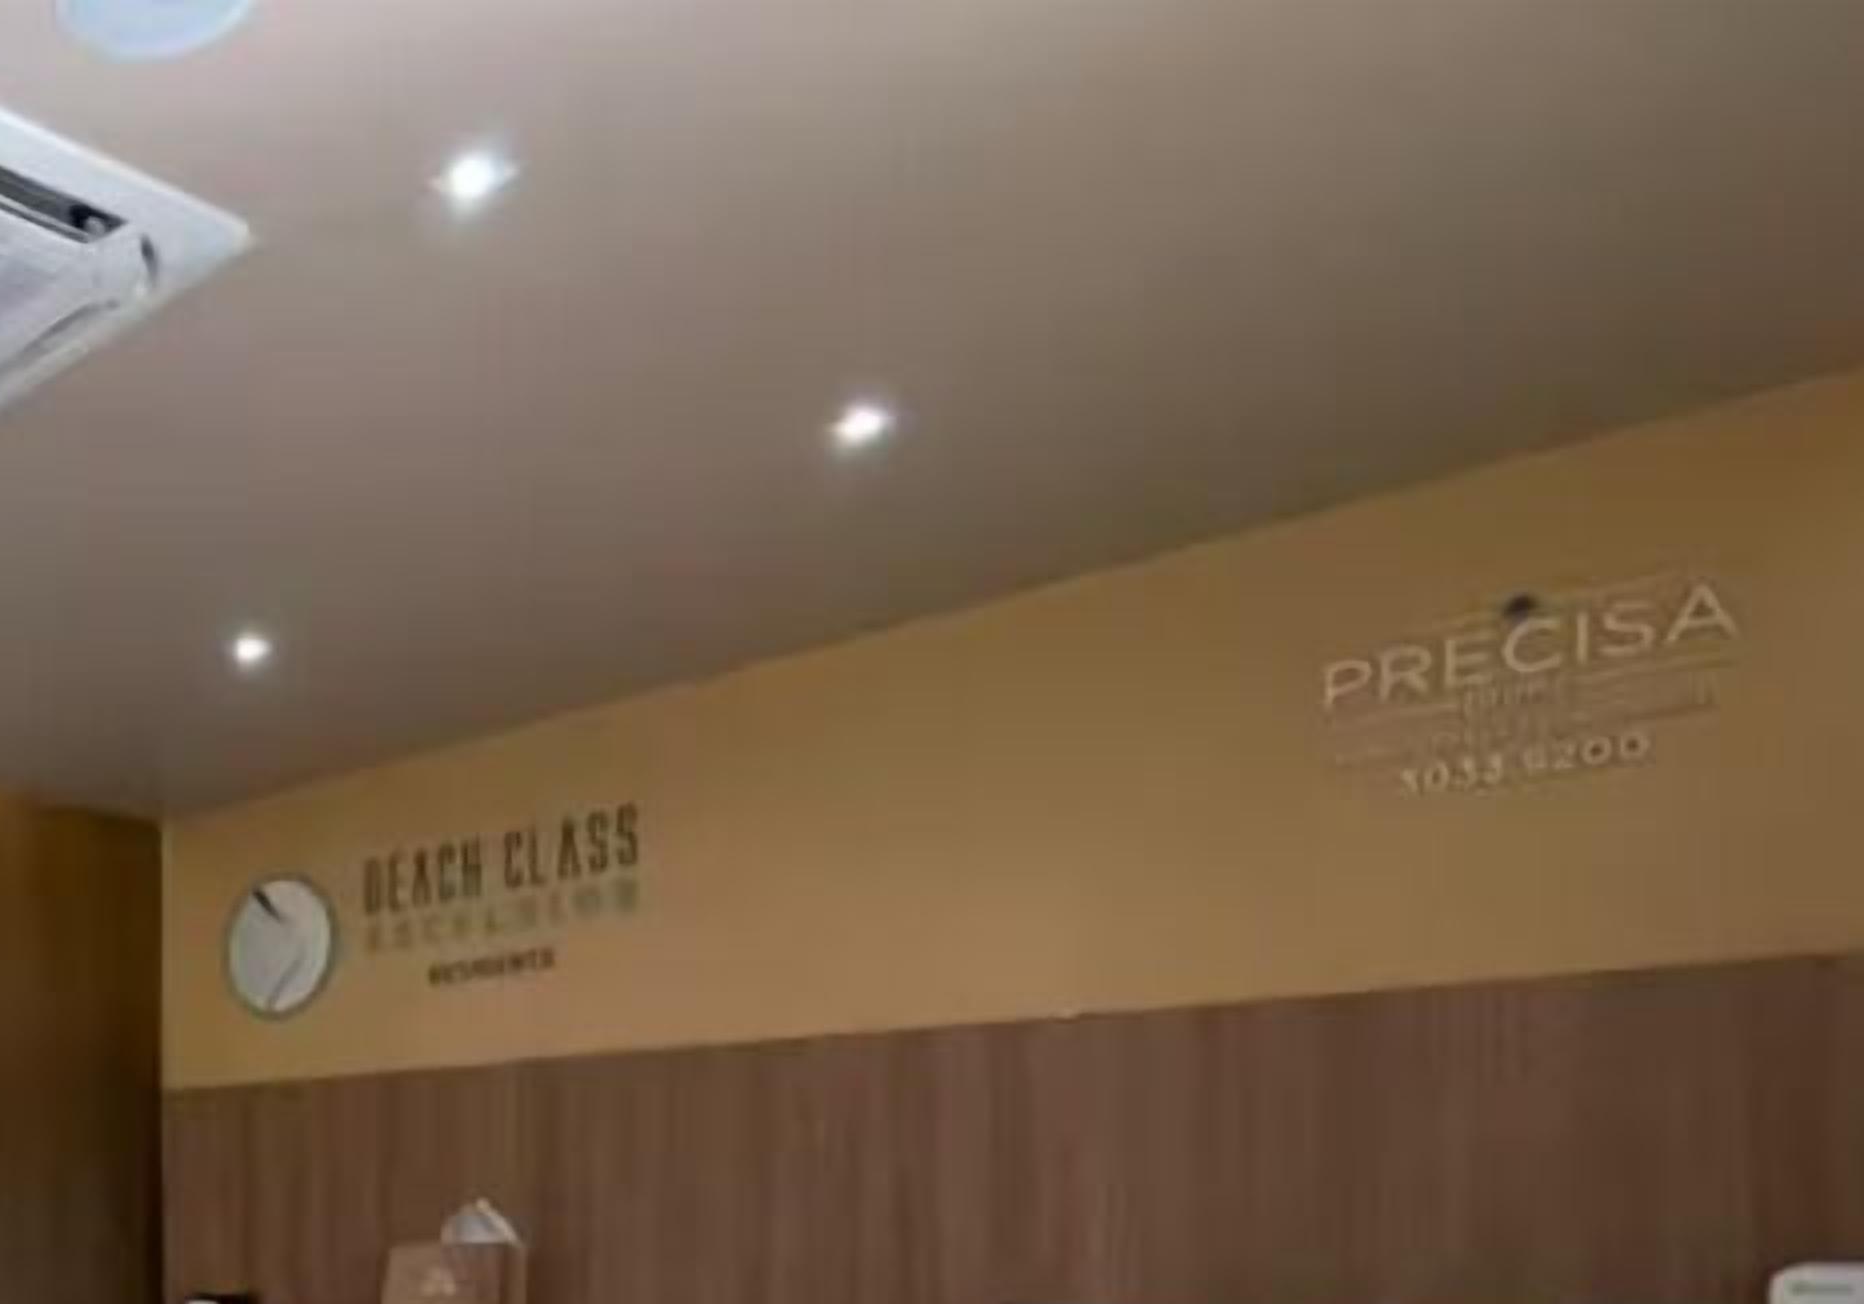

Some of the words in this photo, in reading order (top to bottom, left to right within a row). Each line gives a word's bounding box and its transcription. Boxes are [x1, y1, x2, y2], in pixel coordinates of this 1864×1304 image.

[1322, 583, 1741, 710] PRECISA
[364, 833, 482, 915] BEACH
[504, 801, 639, 889] CLASS
